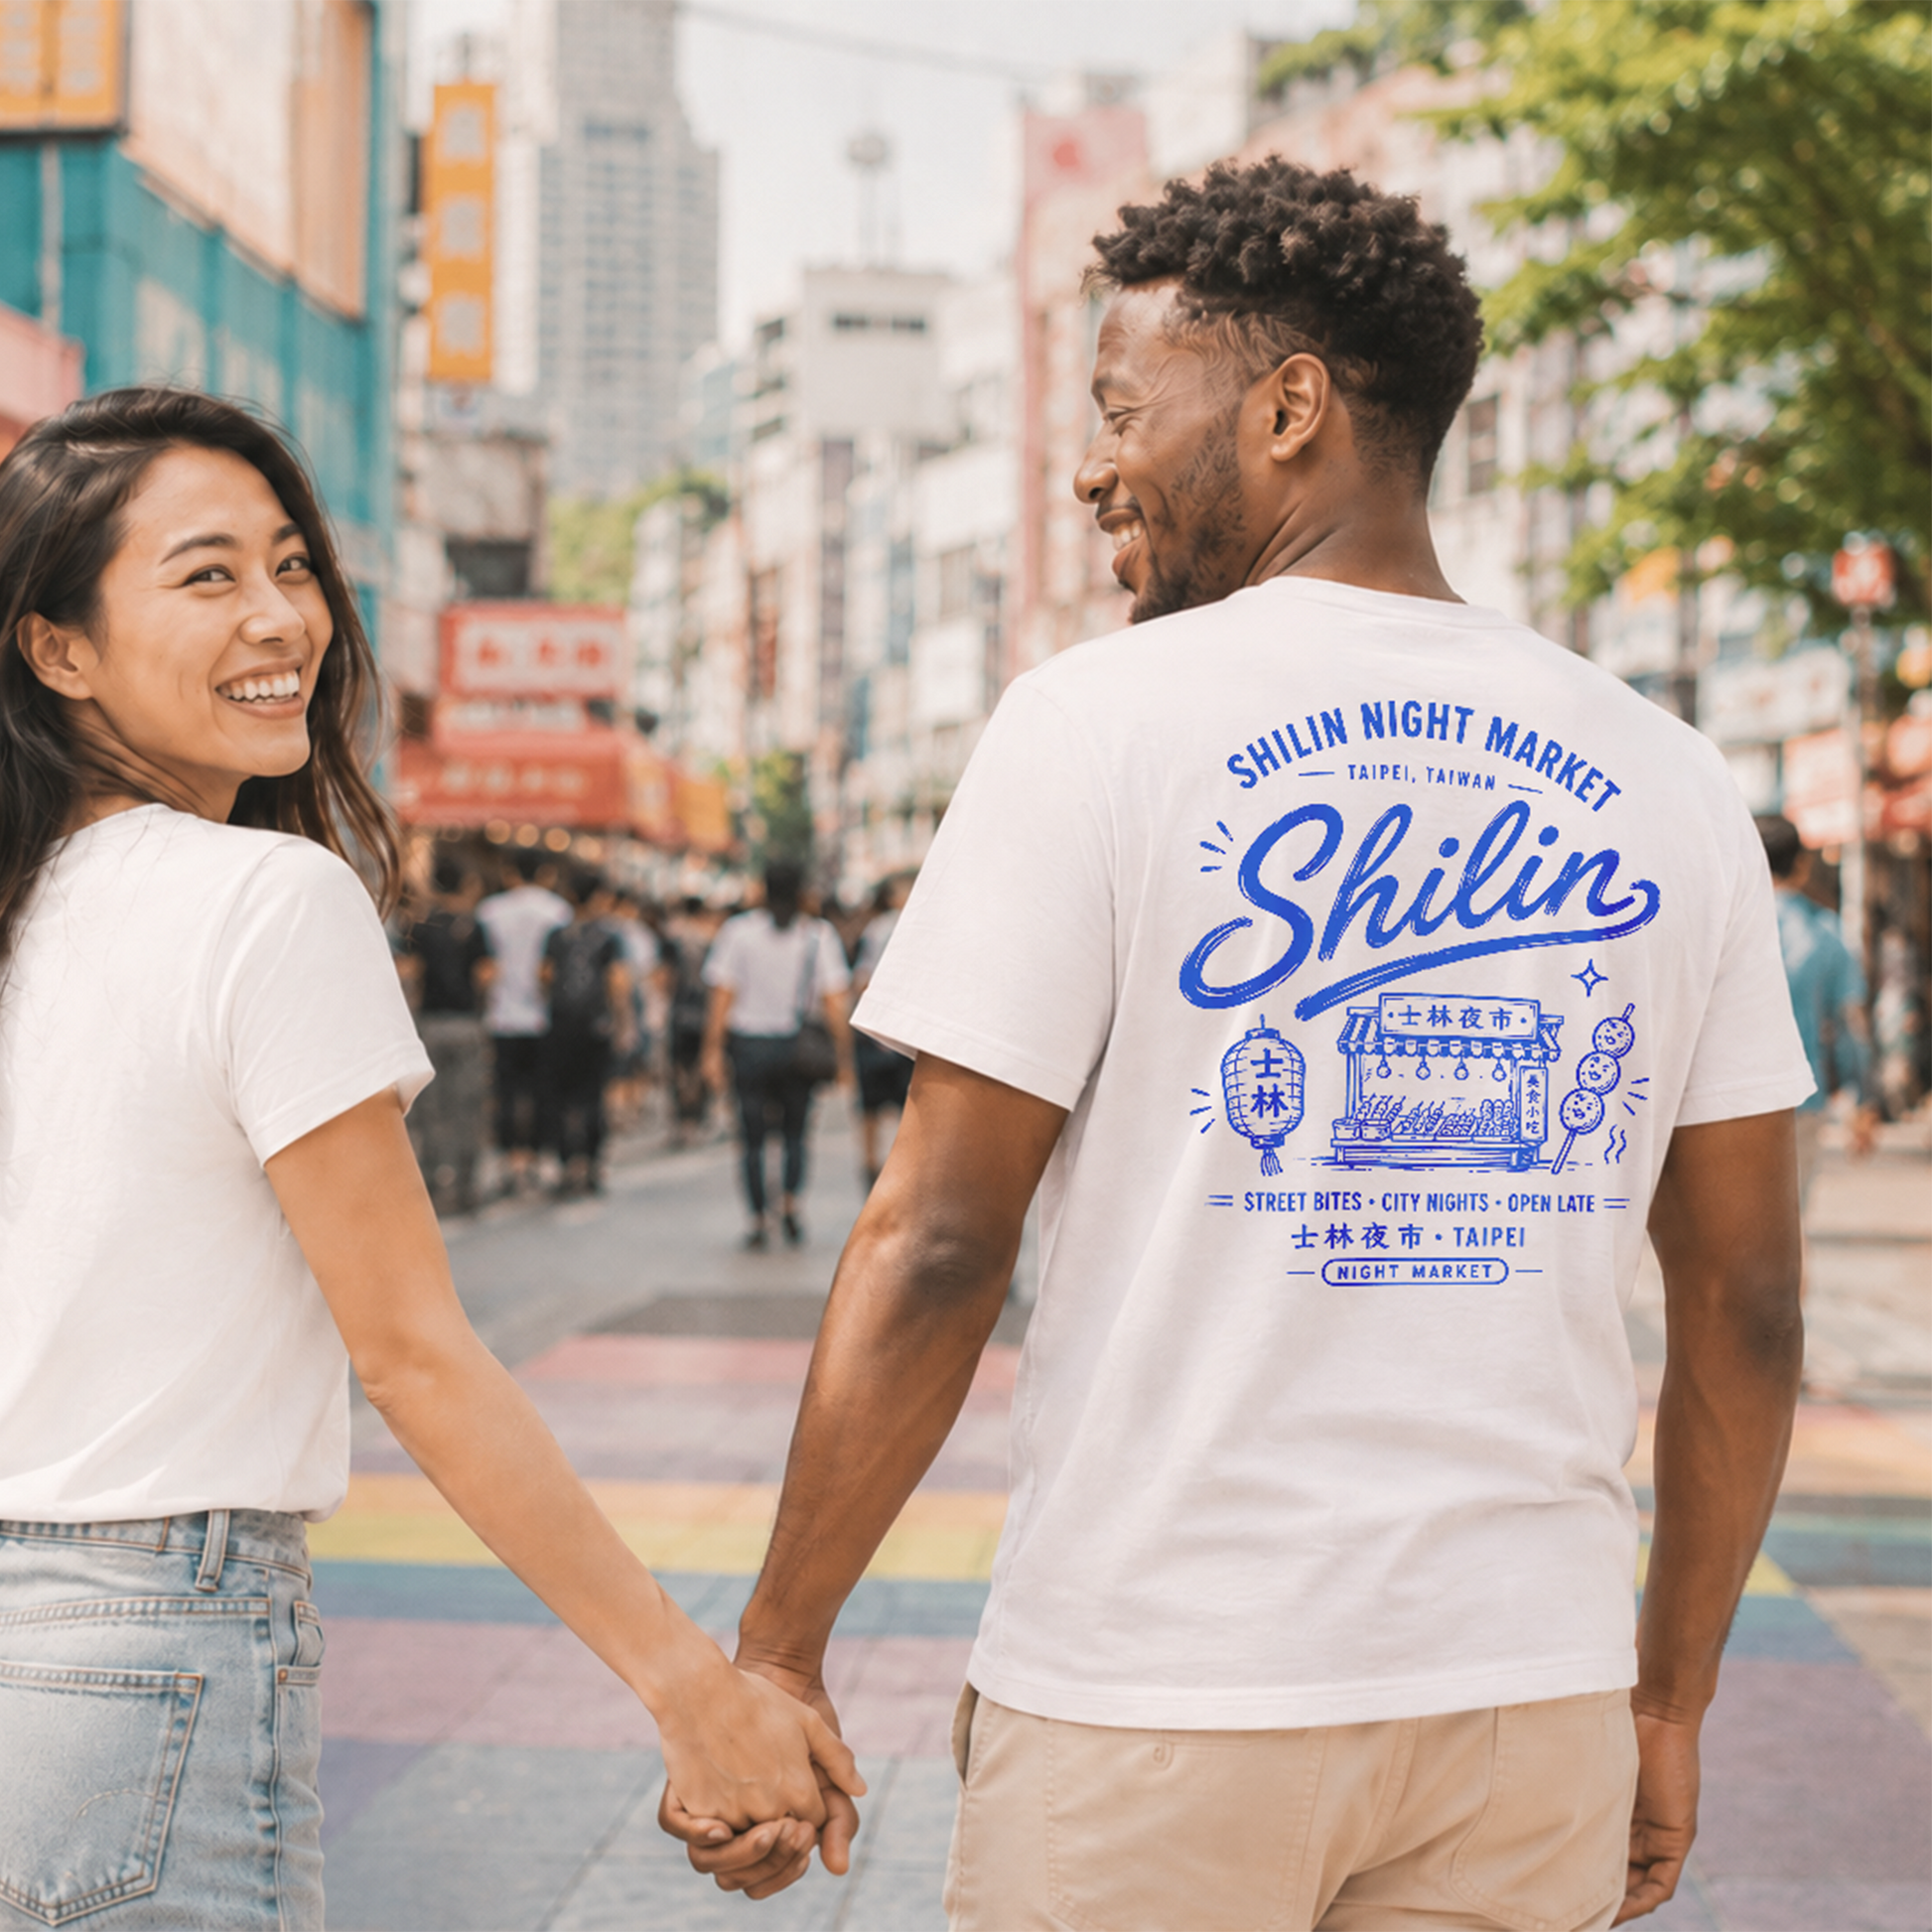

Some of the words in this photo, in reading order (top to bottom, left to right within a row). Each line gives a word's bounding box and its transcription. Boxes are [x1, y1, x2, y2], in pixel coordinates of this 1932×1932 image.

[1227, 708, 1347, 788] SHILIN
[1361, 701, 1474, 744] NIGHT
[1485, 716, 1621, 812] MARKET
[1348, 764, 1416, 783] TAIPEI,
[1427, 766, 1495, 790] TAIWAN
[1179, 800, 1660, 1020] Shilin
[1398, 1005, 1512, 1031] 士林夜市
[1250, 1047, 1289, 1119] 士林
[1244, 1191, 1307, 1211] STREET
[1313, 1191, 1361, 1211] BITES
[1382, 1192, 1420, 1211] CITY
[1427, 1193, 1488, 1211] NIGHTS
[1508, 1193, 1551, 1212] OPEN
[1558, 1195, 1594, 1212] LATE
[1292, 1222, 1424, 1249] 士林夜市
[1453, 1227, 1524, 1247] TAIPEI
[1337, 1265, 1399, 1279] NIGHT
[1413, 1265, 1491, 1278] MARKET
